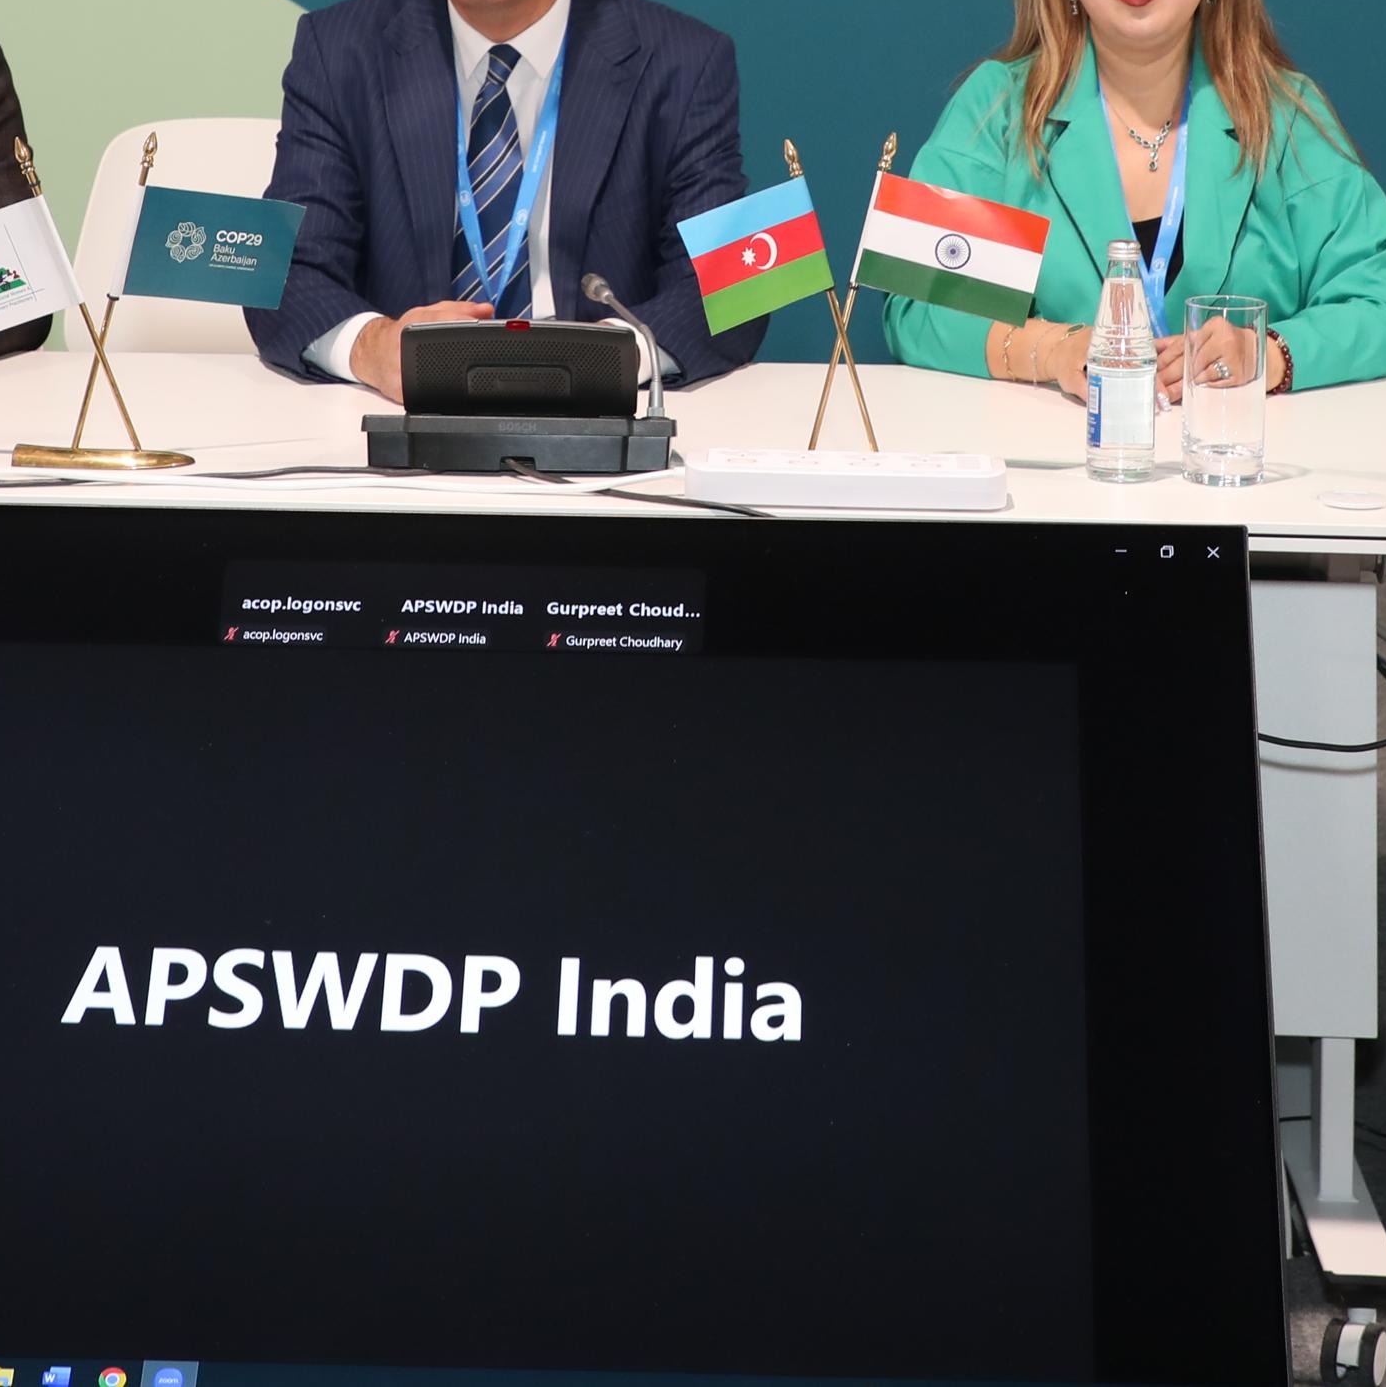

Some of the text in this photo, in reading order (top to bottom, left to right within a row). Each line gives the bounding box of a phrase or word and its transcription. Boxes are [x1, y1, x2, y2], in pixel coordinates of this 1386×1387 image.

[215, 229, 264, 247] COP29
[213, 243, 236, 255] Baku
[210, 252, 258, 267] Azerbaijan
[241, 596, 362, 614] acop.logonsvc
[401, 599, 524, 615] APSWDP India
[546, 602, 623, 618] Gurpreet
[242, 628, 324, 644] acop.logonsvc
[403, 632, 487, 645] APSWDP India
[565, 635, 683, 651] Gurpreet Choudhary
[60, 945, 803, 1042] APSWDP India
